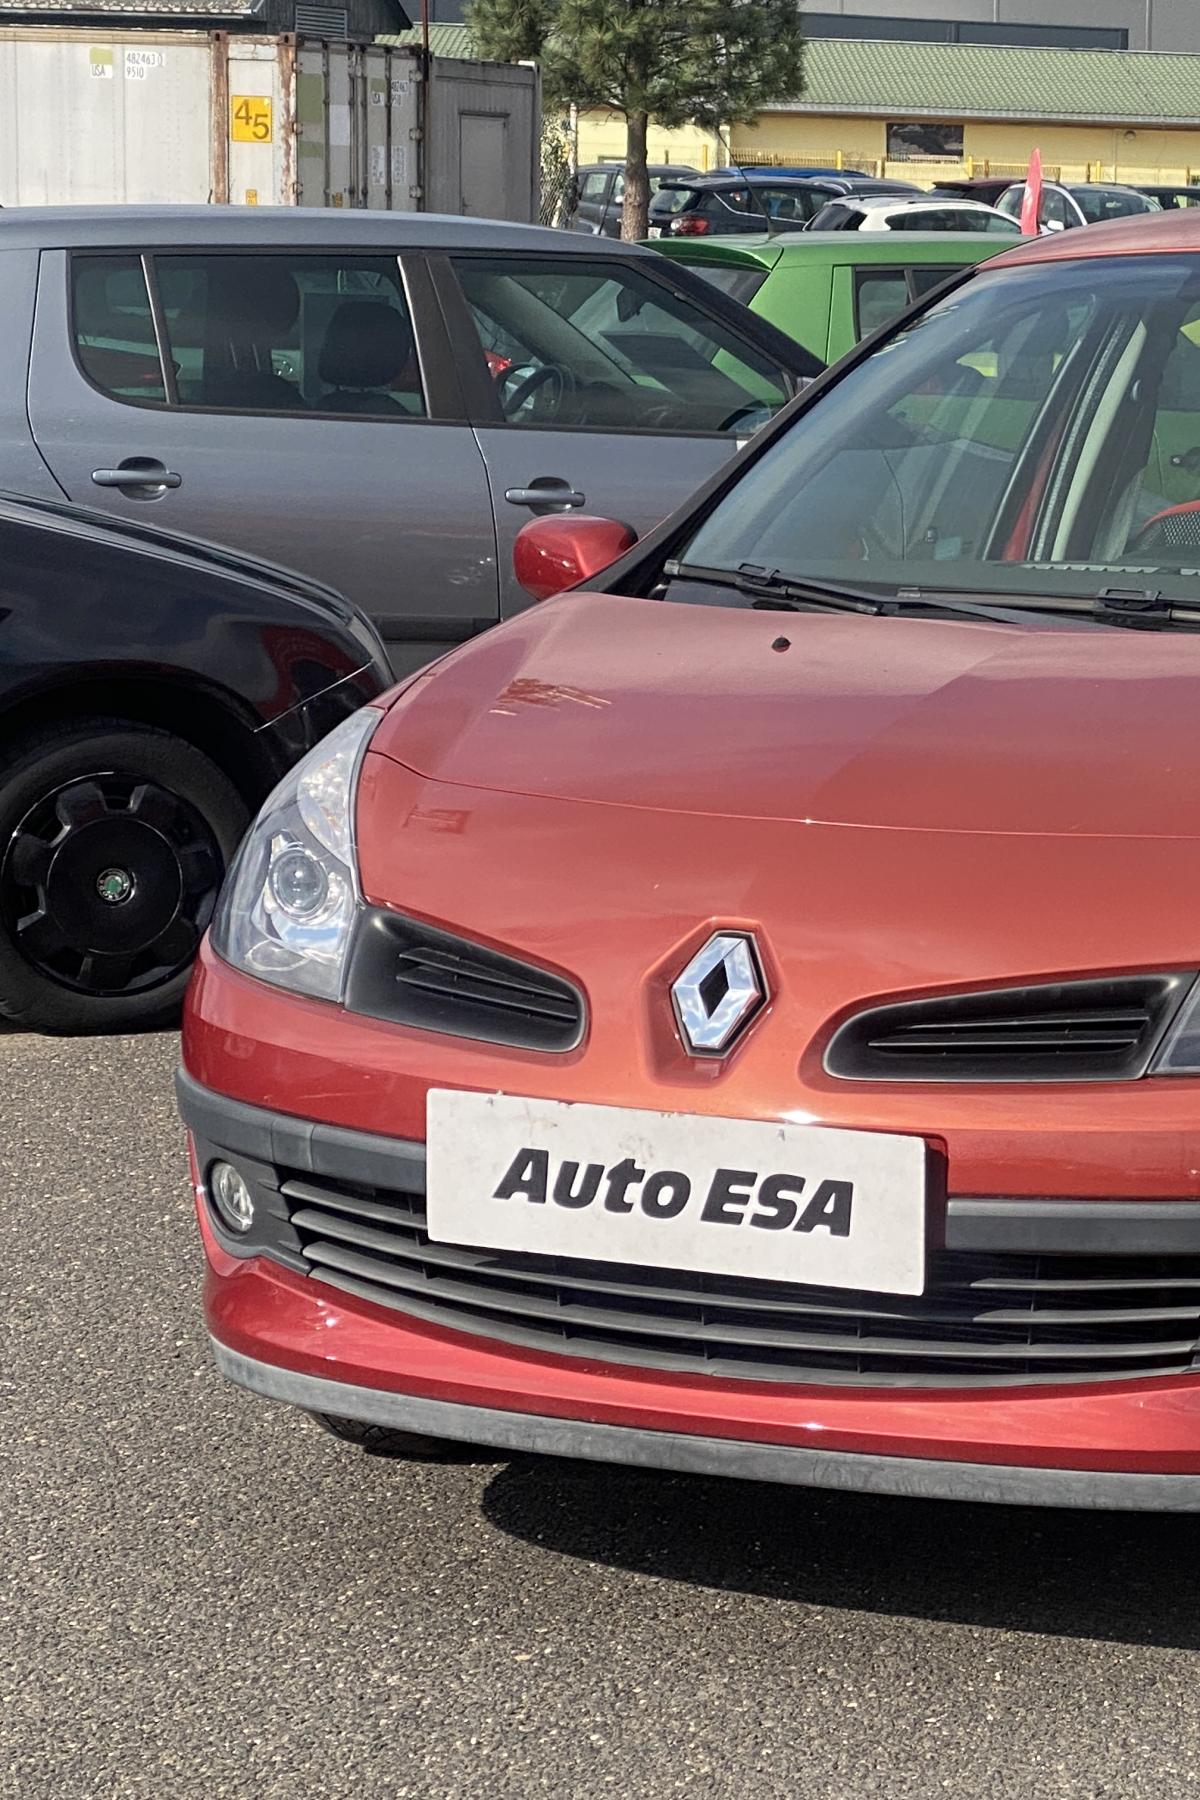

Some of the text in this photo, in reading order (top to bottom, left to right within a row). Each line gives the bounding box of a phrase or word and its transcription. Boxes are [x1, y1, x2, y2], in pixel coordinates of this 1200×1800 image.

[91, 64, 106, 77] USA
[126, 66, 145, 78] 9510
[492, 1147, 854, 1238] Auto ESA
